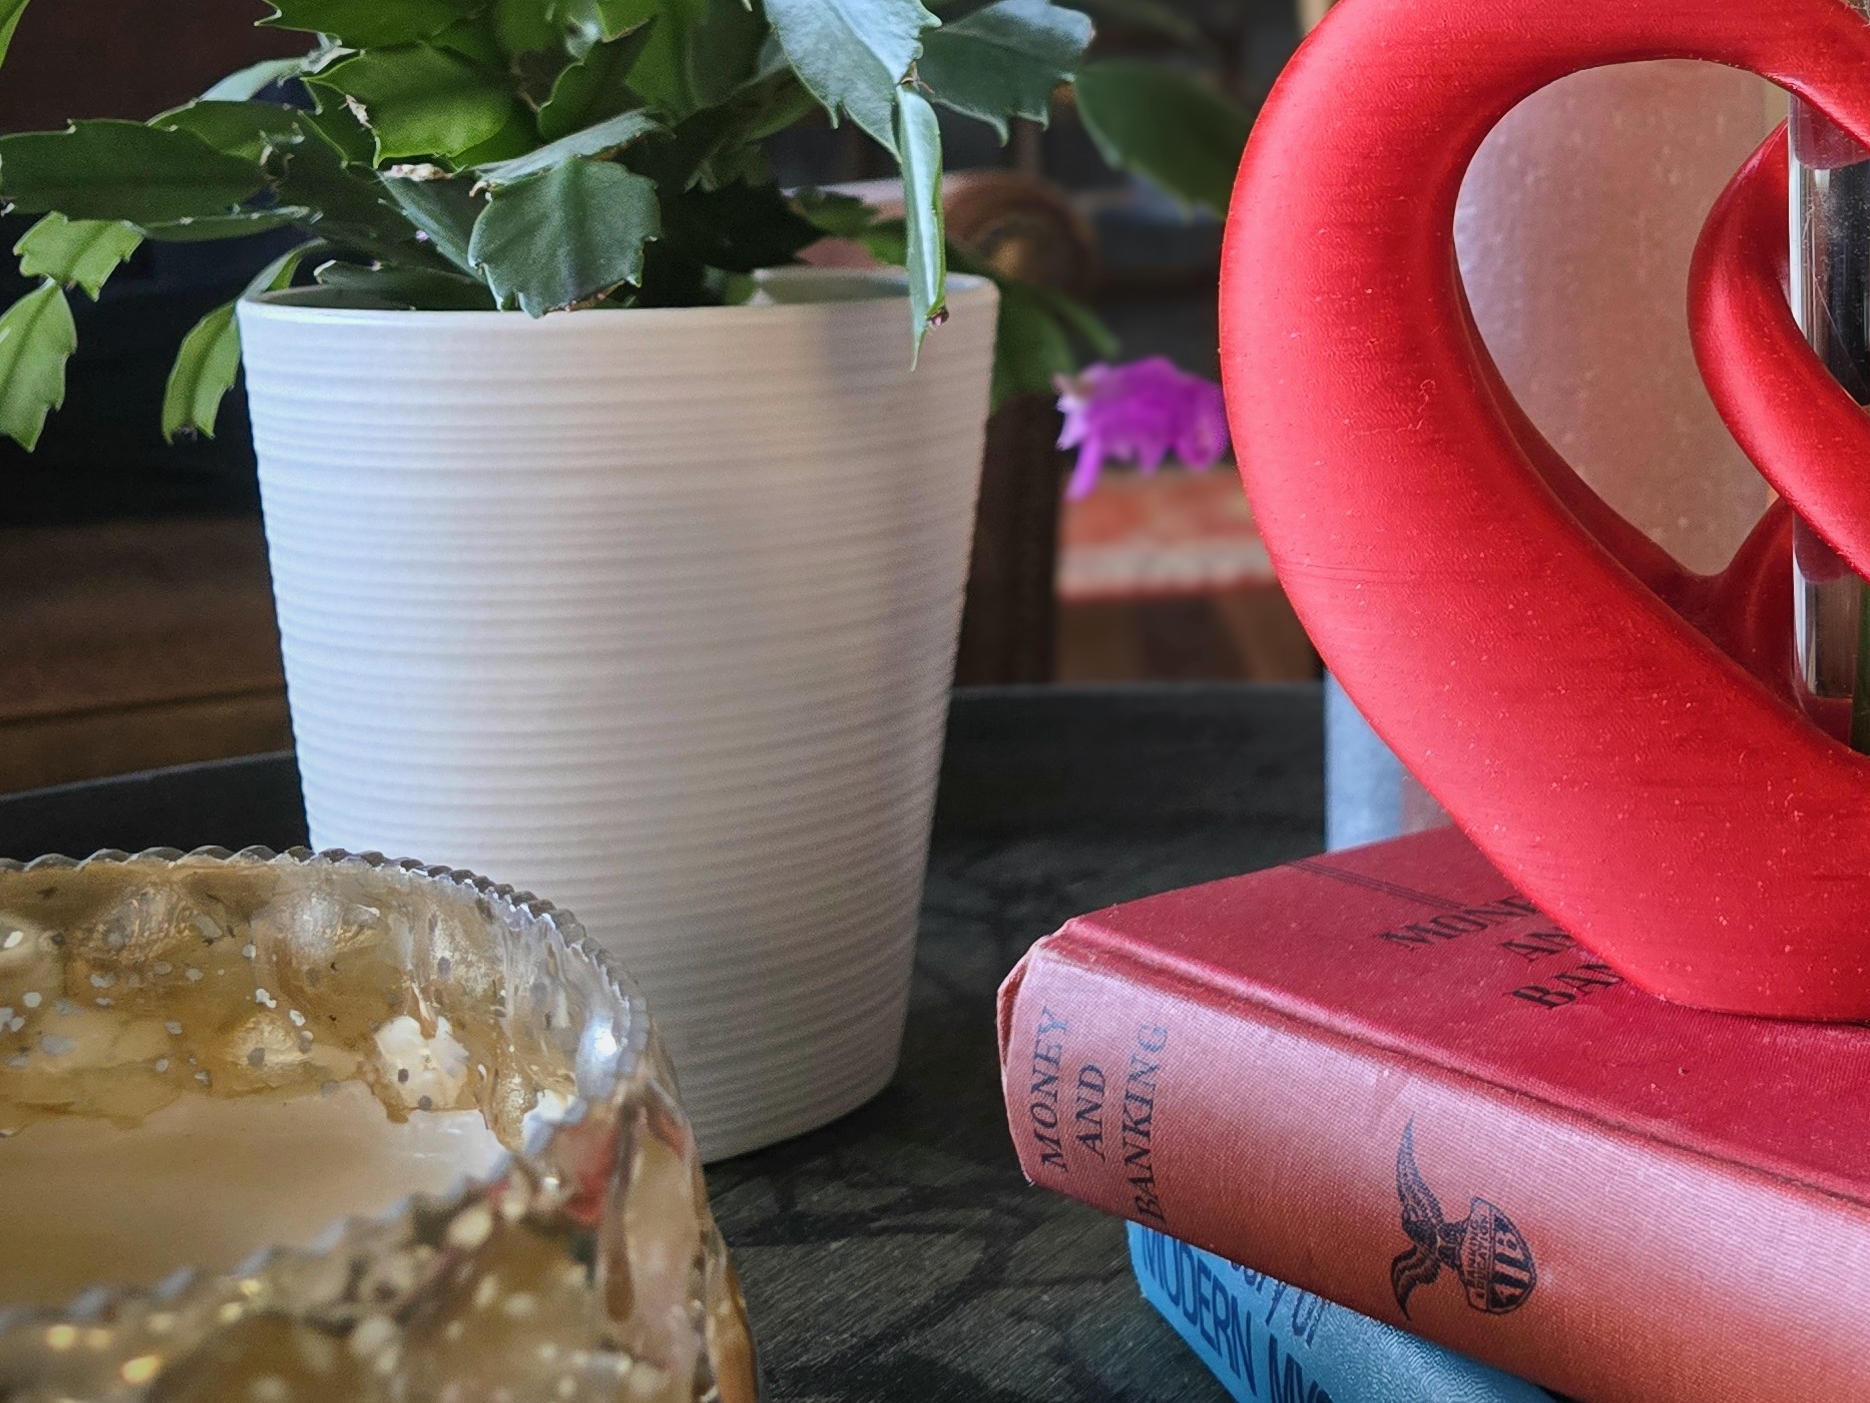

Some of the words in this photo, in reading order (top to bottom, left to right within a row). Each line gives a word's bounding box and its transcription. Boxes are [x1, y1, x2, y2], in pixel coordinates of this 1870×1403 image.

[1375, 895, 1538, 950] MONE
[1500, 927, 1578, 963] AN
[1029, 1004, 1068, 1174] MONEY
[1075, 1063, 1107, 1164] AND
[1121, 1022, 1168, 1225] BANKING
[1141, 1226, 1257, 1396] MODERN
